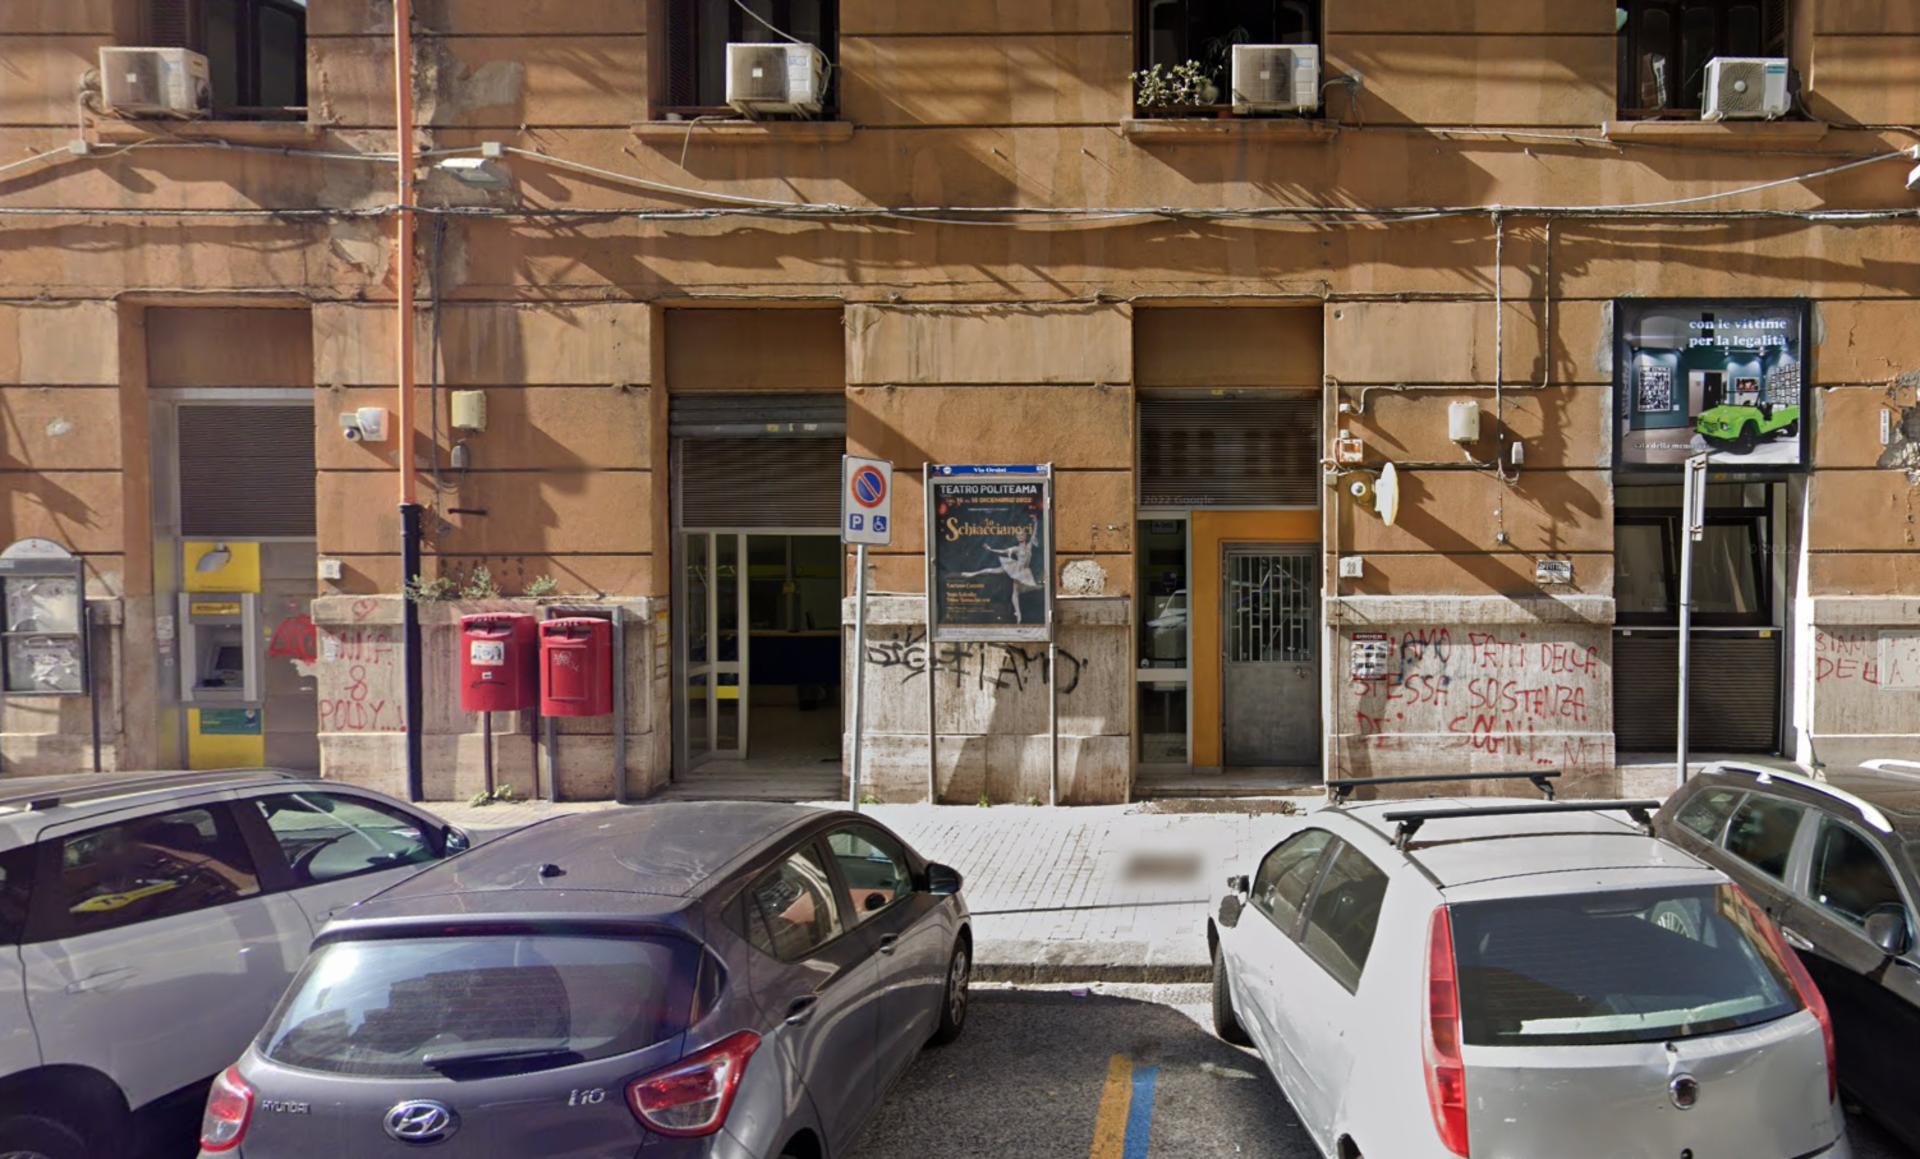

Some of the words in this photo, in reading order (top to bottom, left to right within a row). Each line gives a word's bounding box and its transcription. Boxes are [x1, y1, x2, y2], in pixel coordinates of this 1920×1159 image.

[1689, 319, 1714, 329] con
[1718, 318, 1730, 329] le
[1735, 318, 1787, 329] vittime
[1689, 336, 1714, 348] per
[1717, 335, 1730, 346] la
[1733, 334, 1786, 348] legalità
[940, 485, 979, 494] TEATRO
[980, 485, 1038, 494] POLITEAMA
[852, 515, 862, 529] P
[945, 516, 1033, 542] Schiaccianoci
[567, 1087, 606, 1107] i10
[261, 1099, 311, 1114] HYUNDAI
